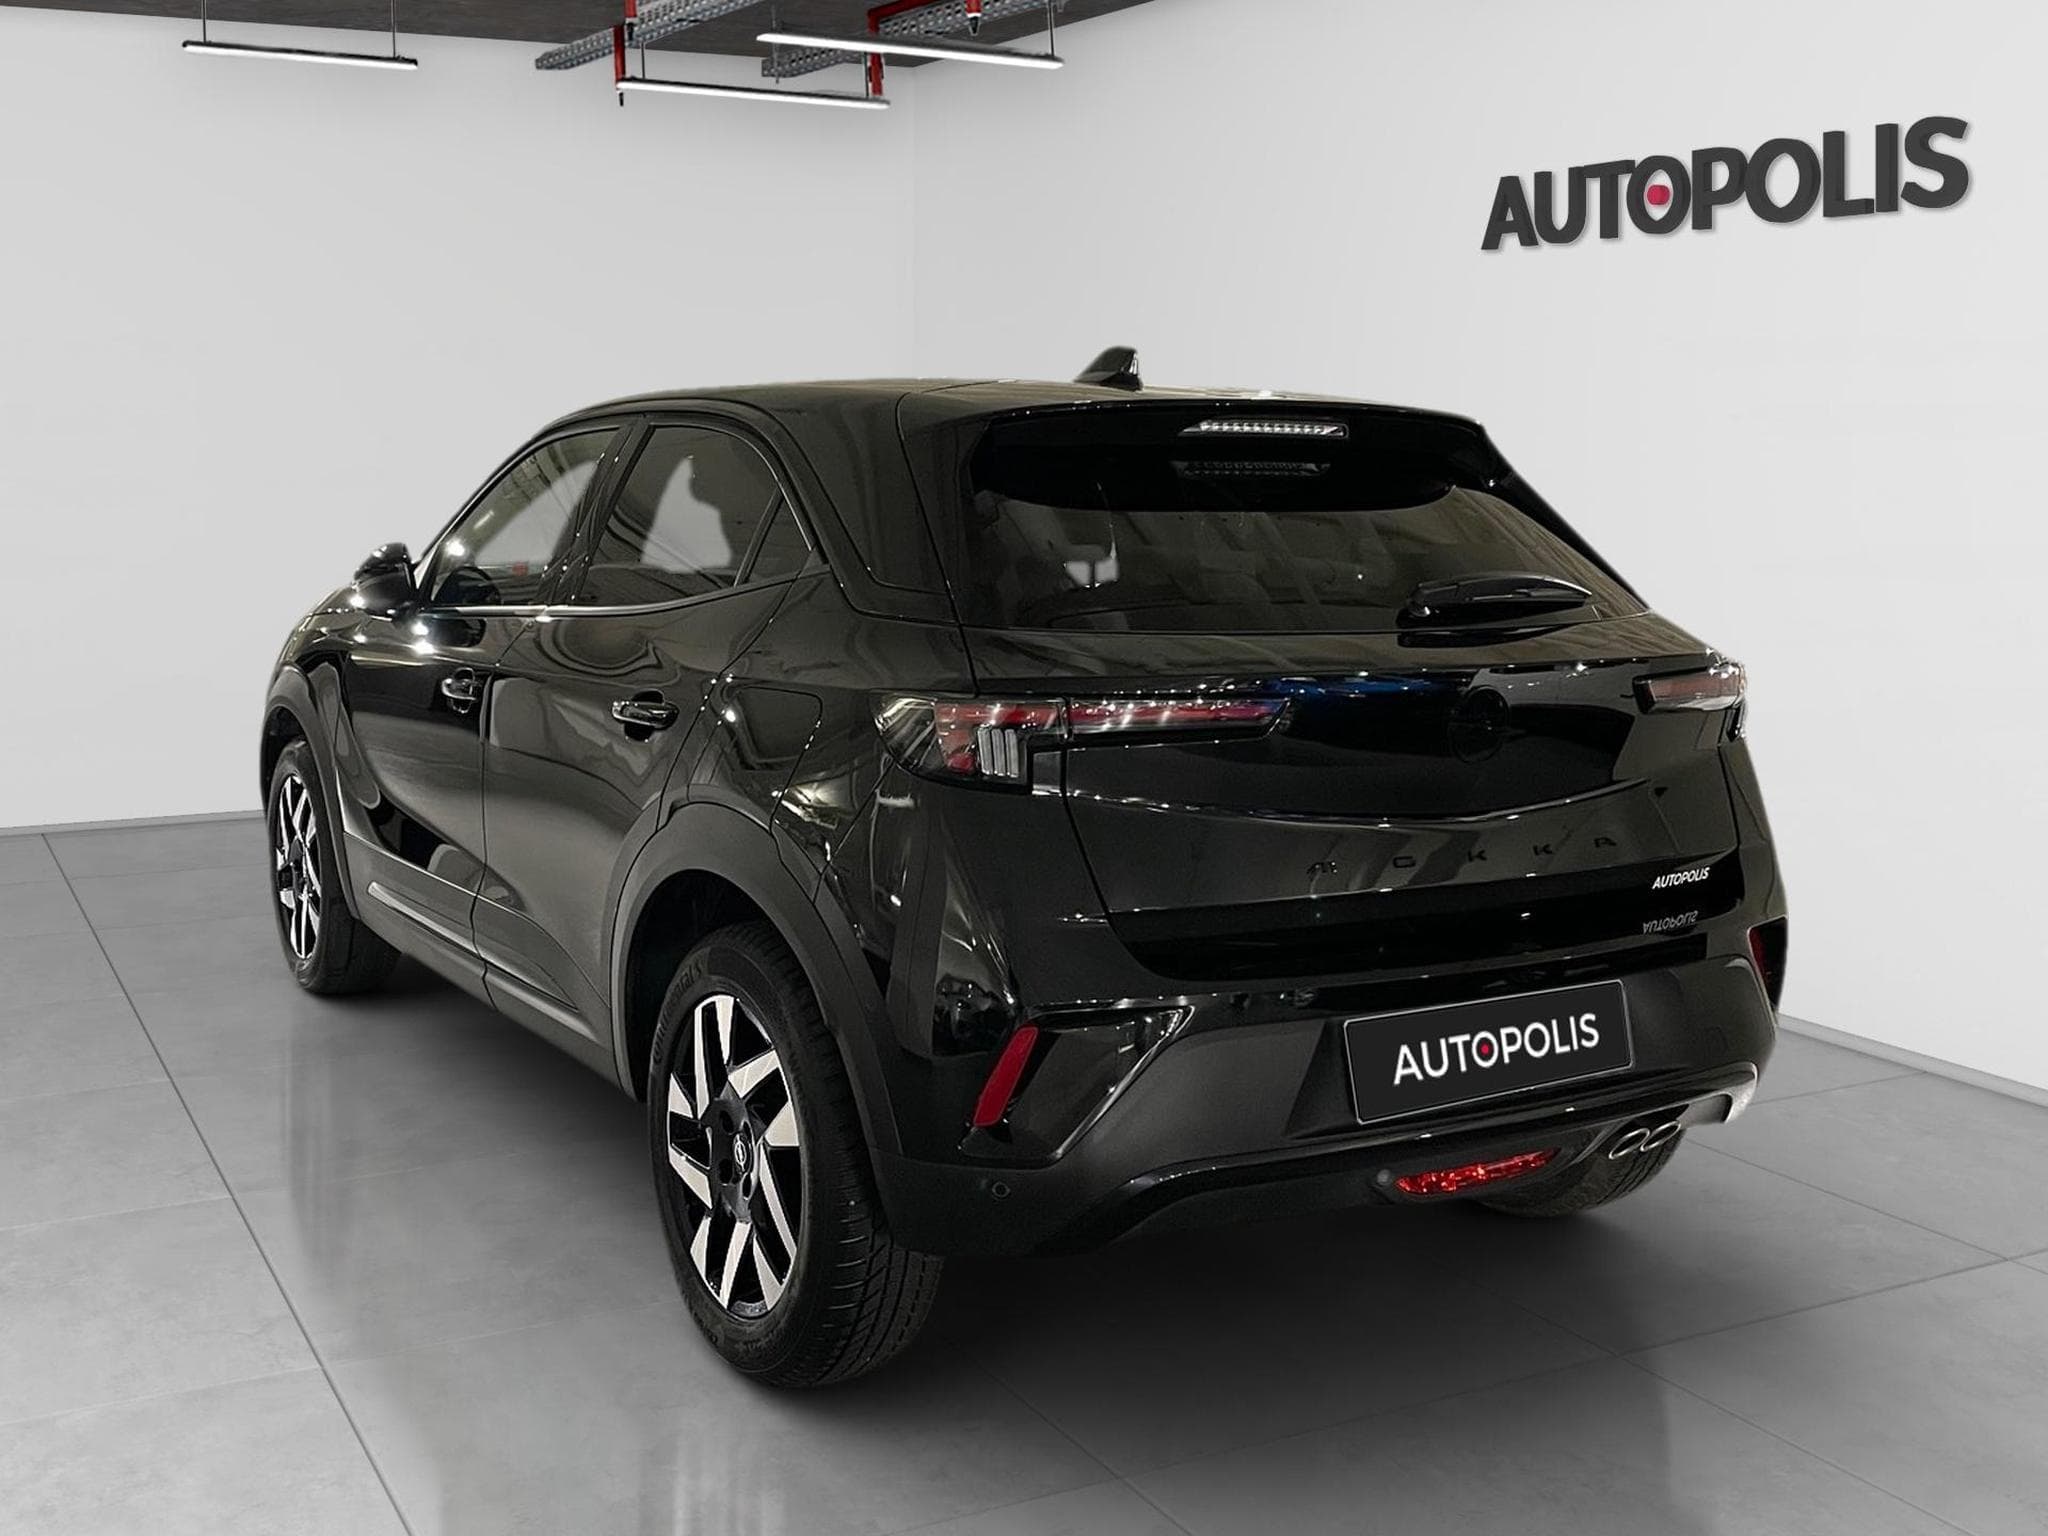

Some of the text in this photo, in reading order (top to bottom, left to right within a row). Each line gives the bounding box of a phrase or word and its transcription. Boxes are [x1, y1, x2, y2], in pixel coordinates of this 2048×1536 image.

[1481, 116, 1969, 250] AUTOPOLIS
[1652, 866, 1710, 889] AUTOPOLIS
[1393, 1013, 1600, 1085] AUTOPOLIS
